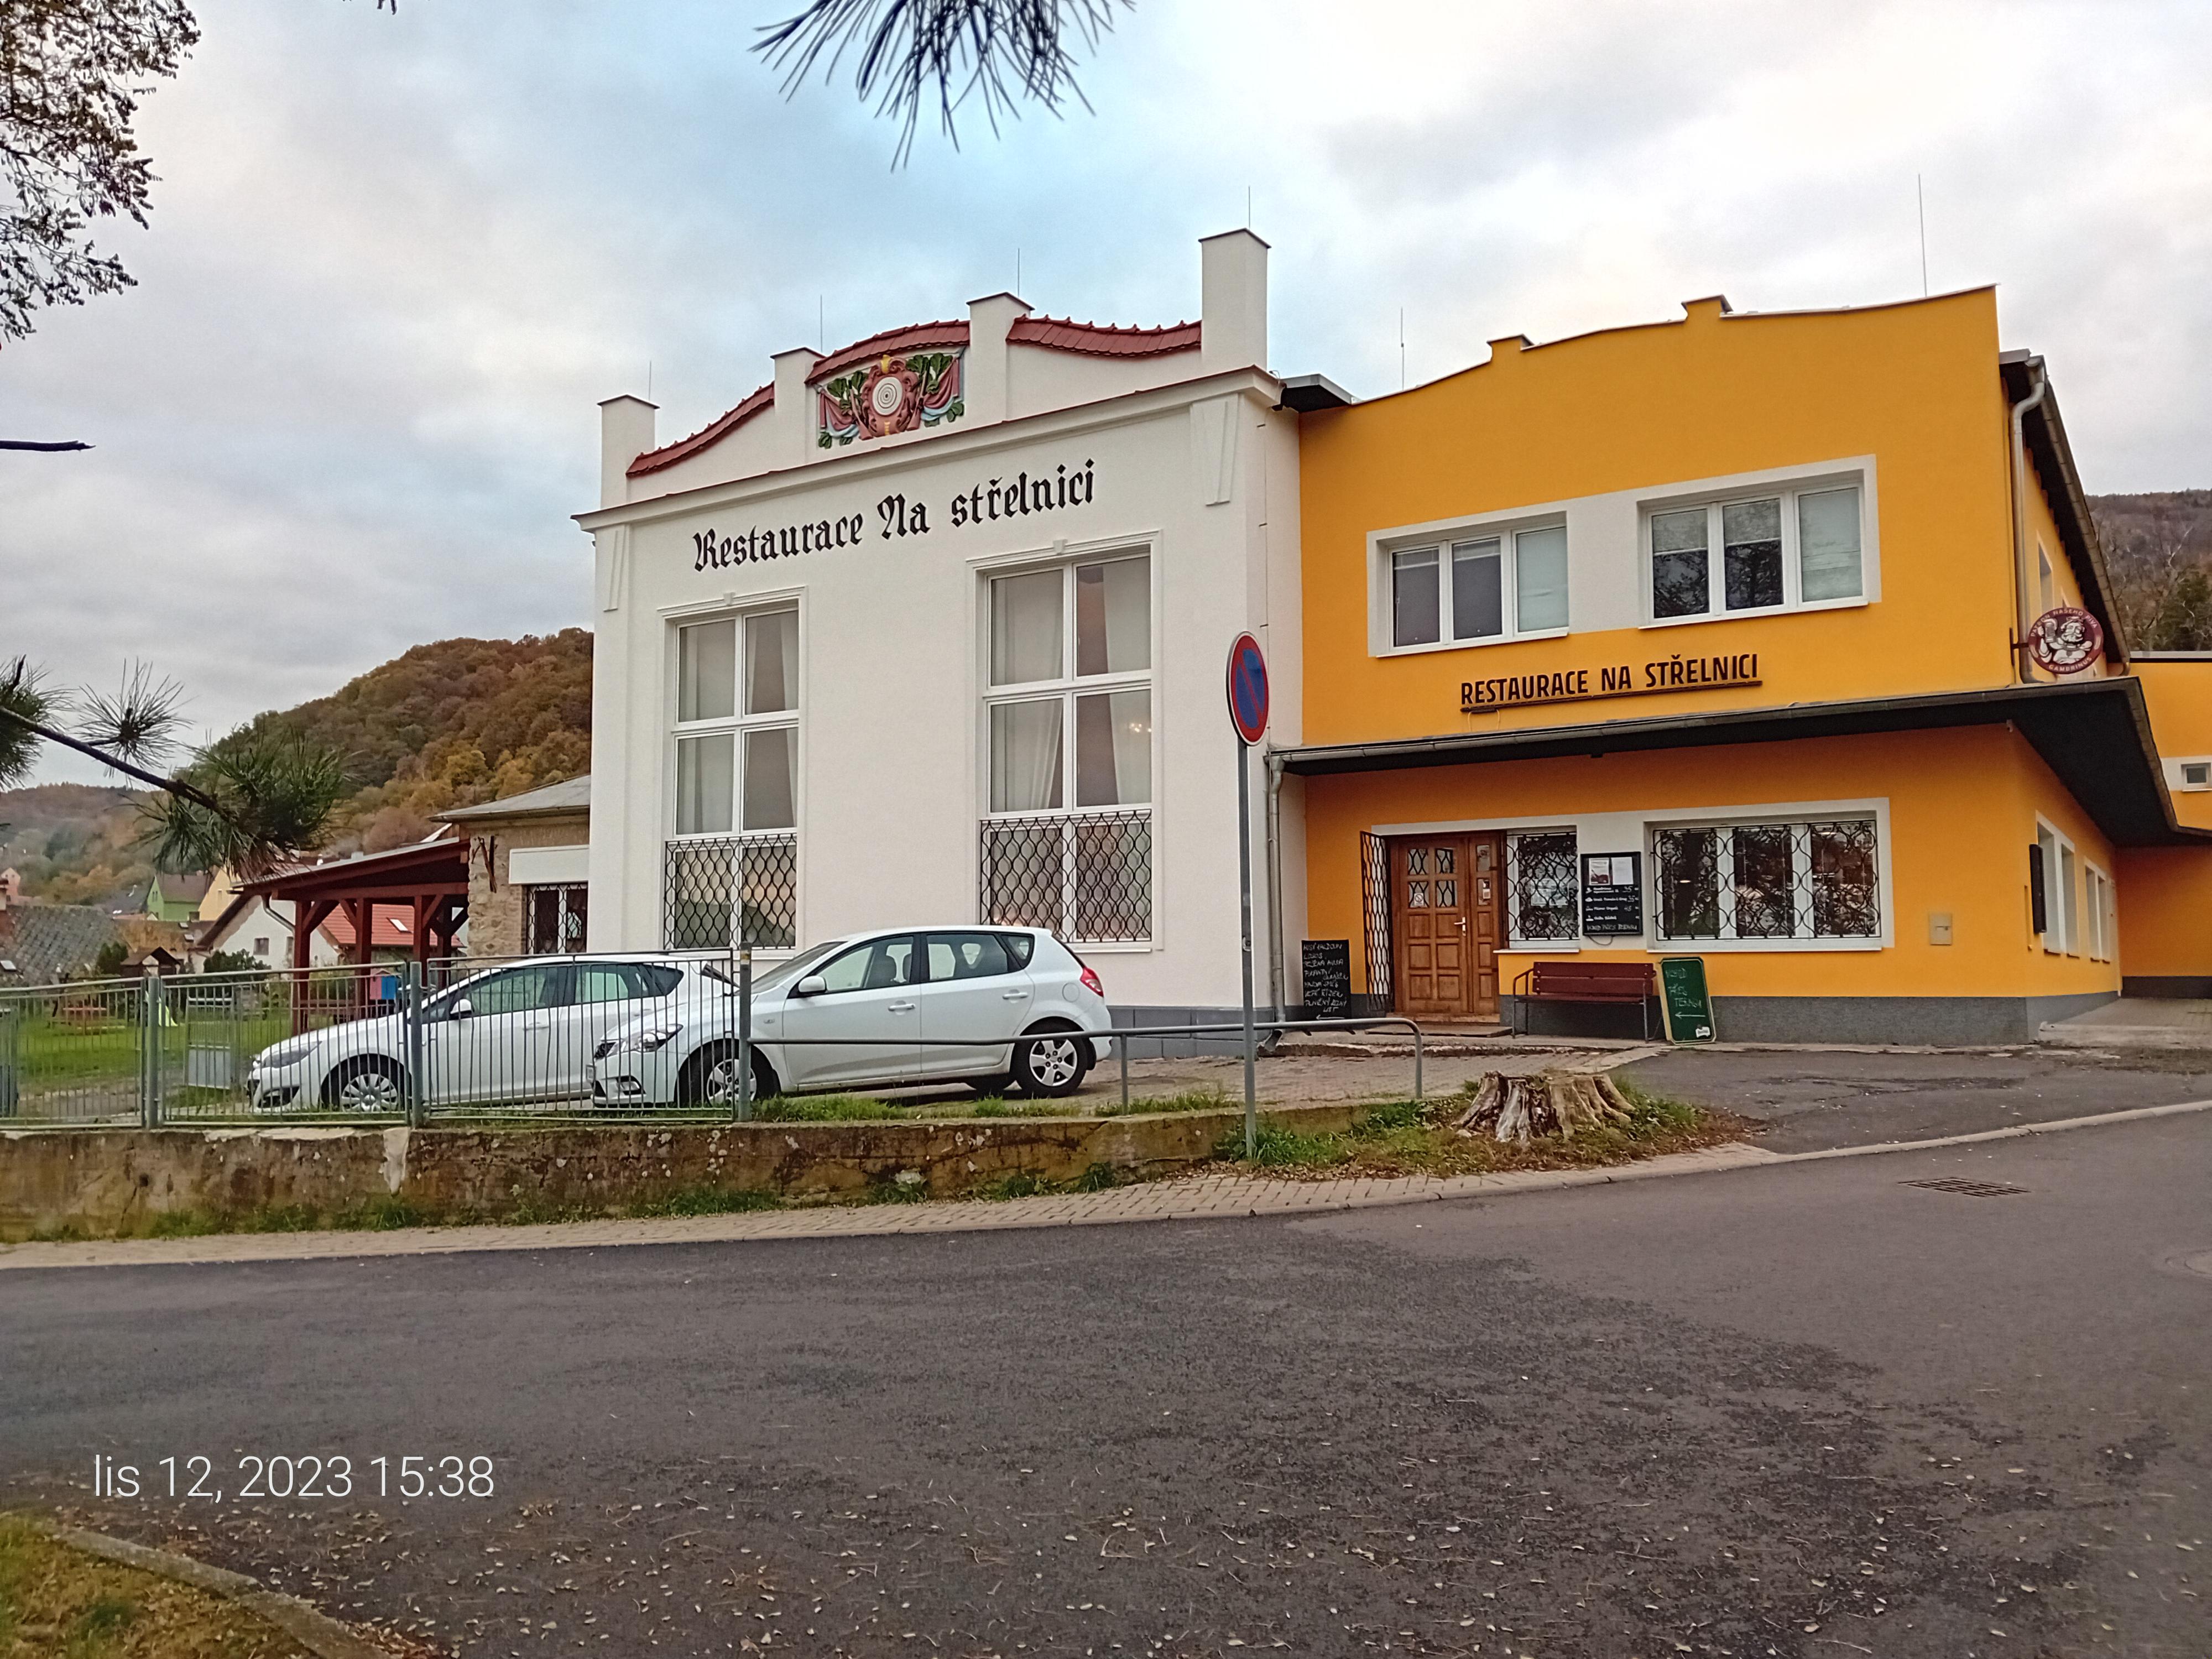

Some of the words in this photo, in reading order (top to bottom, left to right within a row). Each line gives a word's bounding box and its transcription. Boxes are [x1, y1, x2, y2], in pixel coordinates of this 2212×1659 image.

[692, 513, 864, 572] Restaurace
[877, 493, 931, 540] Na
[951, 458, 1095, 528] střelnici
[2084, 614, 2098, 629] PIVA
[1461, 670, 1588, 705] RESTAURACE
[1601, 666, 1632, 691] NA
[1646, 654, 1758, 688] STŘELNICI
[2049, 657, 2092, 671] GAMBRINUS
